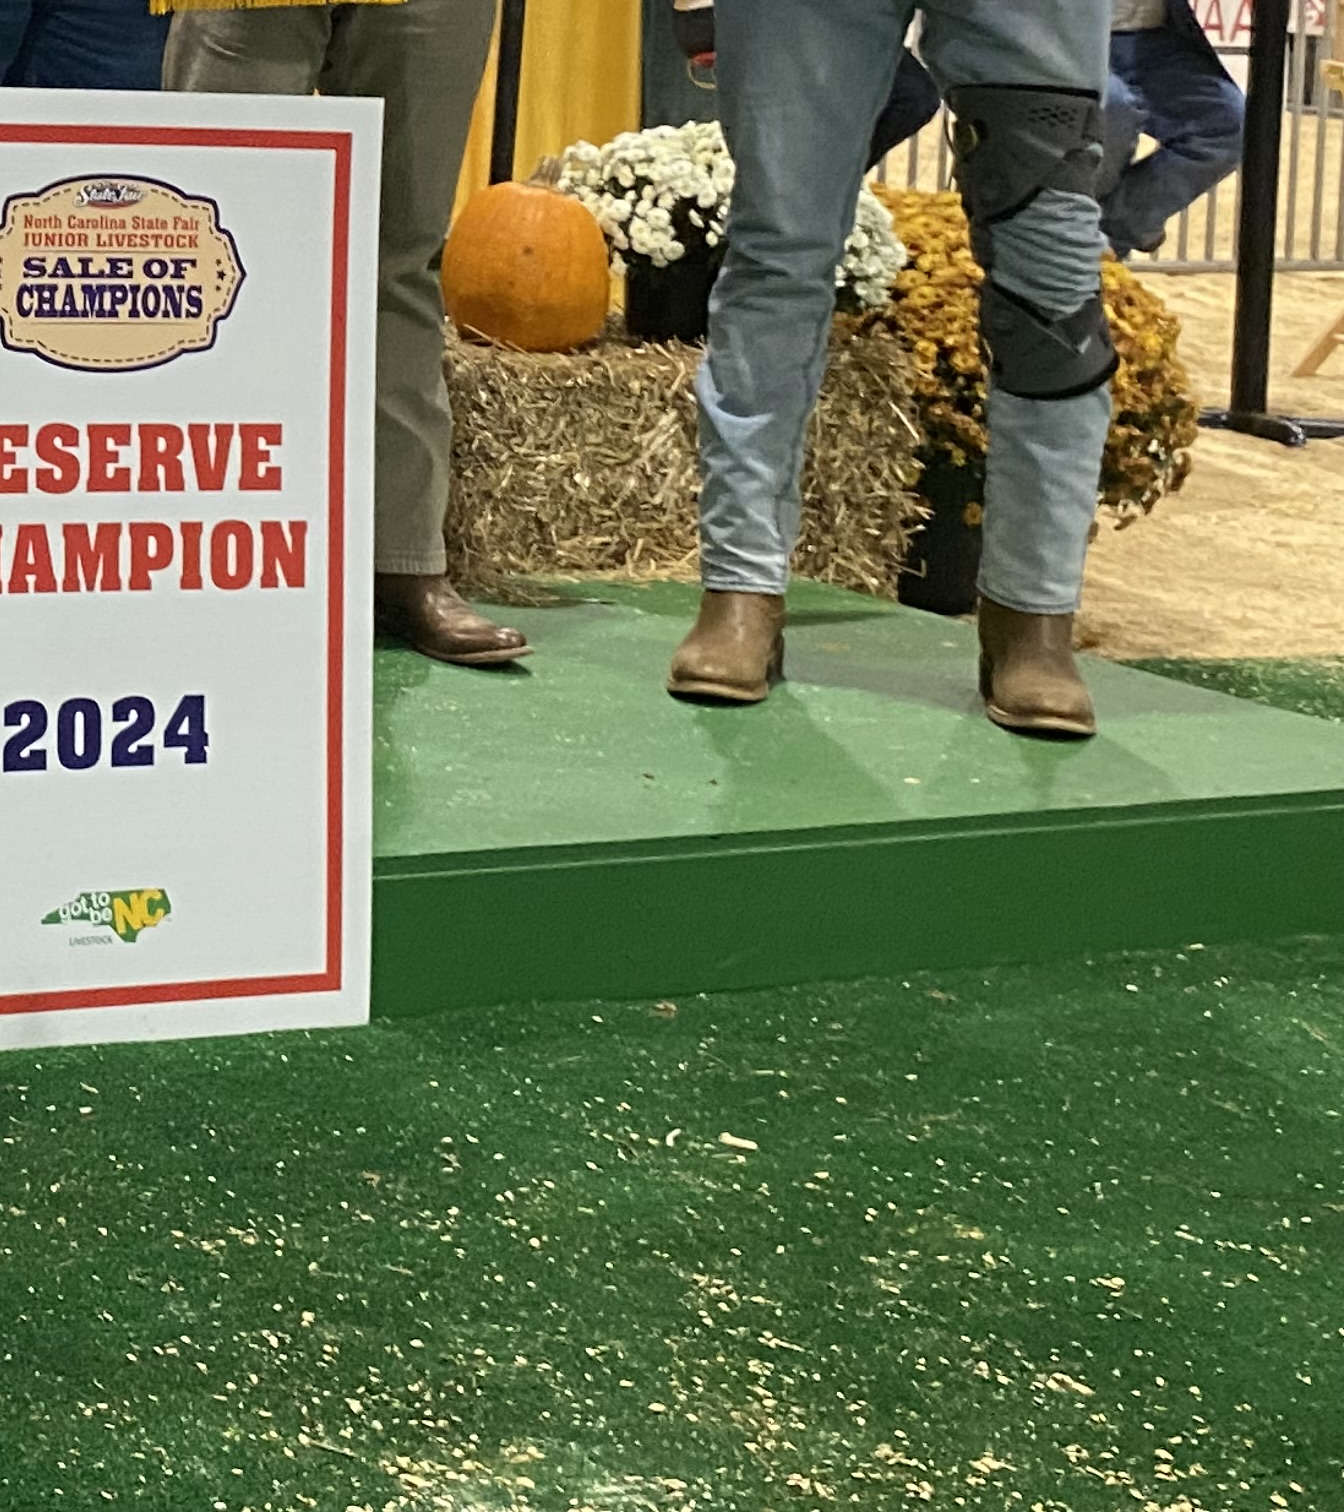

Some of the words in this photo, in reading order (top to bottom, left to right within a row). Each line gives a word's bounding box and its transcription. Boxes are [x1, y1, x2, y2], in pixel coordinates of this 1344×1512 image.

[23, 215, 62, 230] North
[67, 215, 126, 231] Carolina
[132, 216, 168, 231] State
[173, 216, 200, 231] Fair
[23, 233, 88, 248] JUNIOR
[96, 233, 199, 249] LIVESTOCK
[23, 256, 133, 279] SALE
[142, 258, 197, 279] OF
[16, 283, 203, 318] CHAMPIONS
[3, 695, 209, 772] 2024
[59, 895, 89, 924] got
[91, 892, 111, 909] to
[89, 907, 112, 925] be
[113, 888, 165, 935] NC
